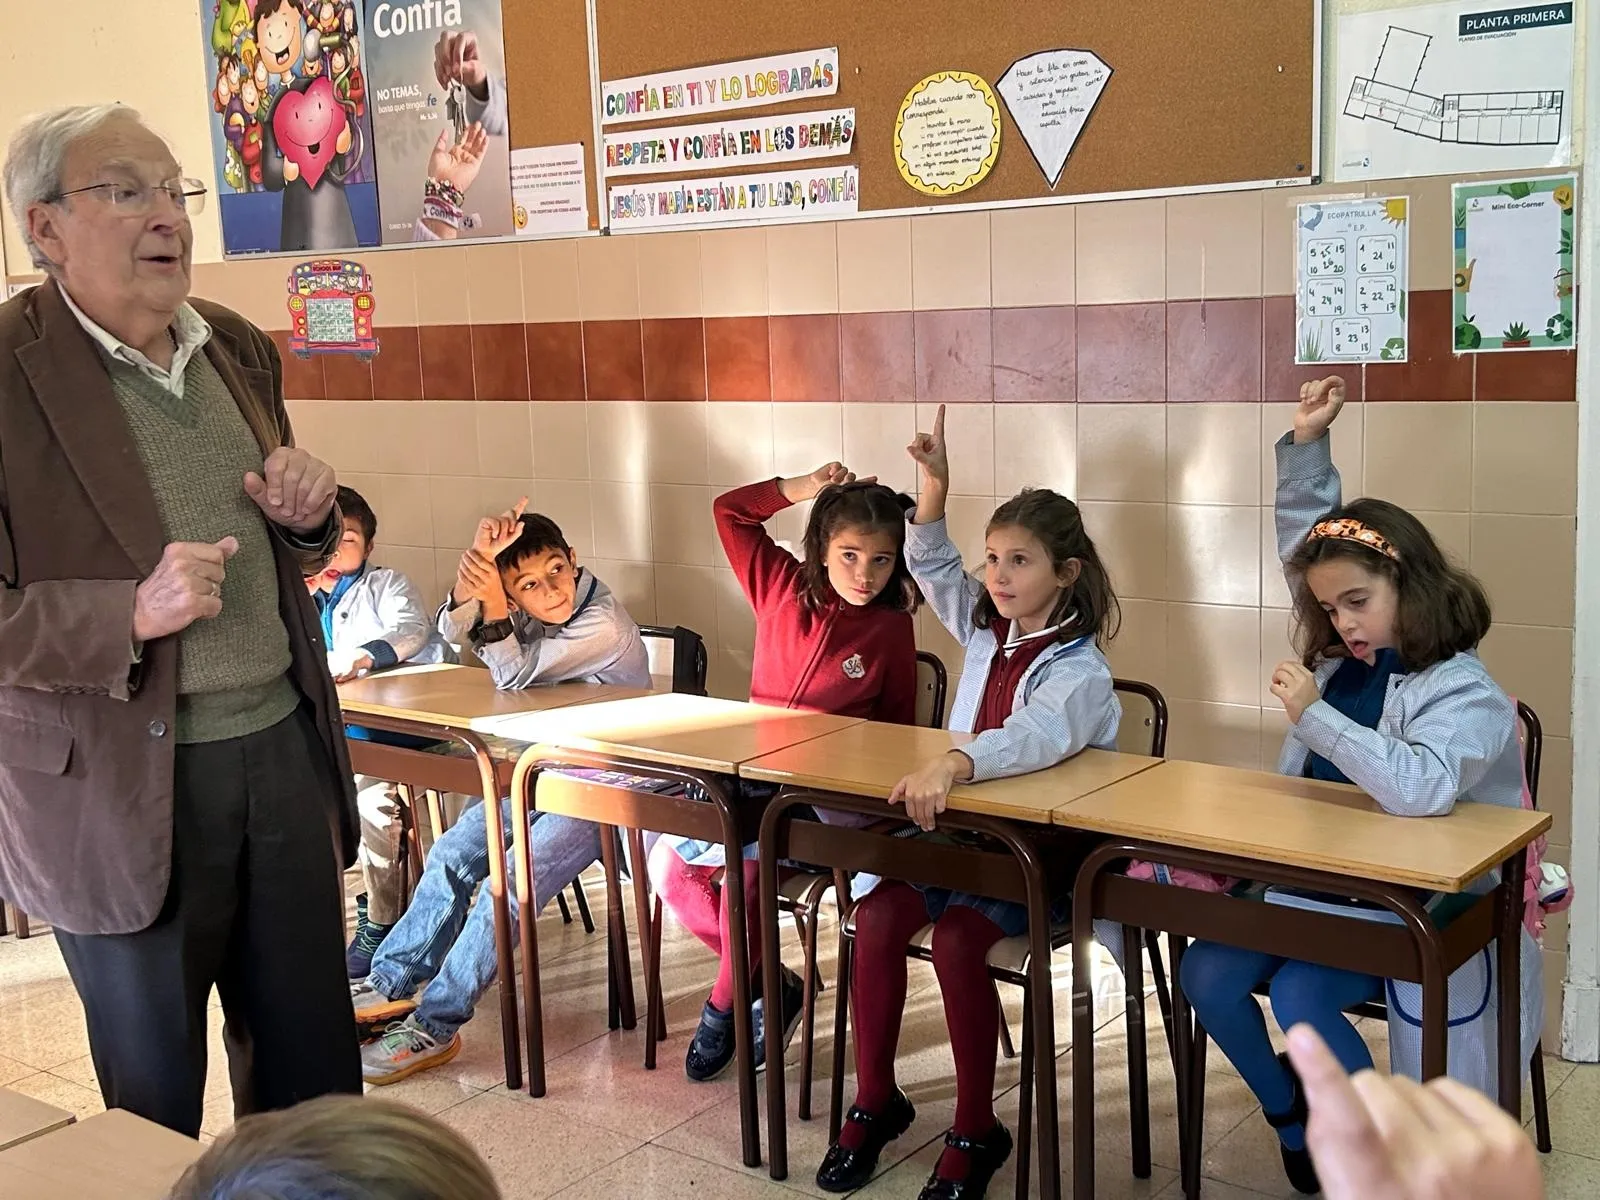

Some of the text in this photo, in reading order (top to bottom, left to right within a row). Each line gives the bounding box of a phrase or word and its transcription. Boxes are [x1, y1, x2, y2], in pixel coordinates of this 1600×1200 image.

[1466, 10, 1565, 30] PLANTA PRIMERA
[1484, 32, 1517, 40] EVACUACIÓN
[1037, 65, 1043, 73] la
[1048, 63, 1059, 72] fila
[1085, 75, 1103, 87] correr
[606, 59, 834, 117] CONFÍA EN TI Y LO LOGRARÁS
[1019, 83, 1023, 91] y
[377, 84, 422, 101] NO TEMAS,
[940, 94, 963, 102] cuando
[394, 103, 405, 113] que
[406, 100, 426, 111] tengas
[427, 93, 437, 106] fe
[967, 125, 985, 133] cuando
[606, 115, 853, 168] RESPETA Y CONFÍA EN LOS DEMÁS
[611, 170, 857, 219] JESÚS Y MARÍA ESTÁN A TU LADO, CONFÍA
[1492, 203, 1506, 211] Mini
[1507, 201, 1545, 210] Eco-Corner
[1327, 210, 1377, 220] ECOPATRULLA
[1336, 245, 1345, 254] 15
[1360, 244, 1365, 252] 1
[1387, 242, 1395, 250] 11
[1310, 249, 1317, 257] 5
[1373, 251, 1383, 260] 21
[1323, 259, 1334, 269] 26
[1333, 264, 1344, 273] 20
[1361, 264, 1367, 272] 6
[1386, 261, 1395, 270] 16
[1310, 266, 1318, 274] 10
[1309, 288, 1315, 297] 4
[1334, 286, 1343, 295] 14
[1360, 287, 1366, 295] 2
[1386, 284, 1395, 292] 12
[1321, 296, 1332, 305] 24
[1372, 292, 1384, 301] 22
[1309, 306, 1315, 314] 9
[1334, 306, 1342, 314] 19
[1361, 303, 1368, 312] 7
[1386, 302, 1396, 312] 17
[1335, 327, 1341, 336] 3
[1361, 325, 1369, 333] 13
[1348, 334, 1358, 343] 23
[1335, 343, 1341, 352] 8
[1361, 343, 1369, 351] 18
